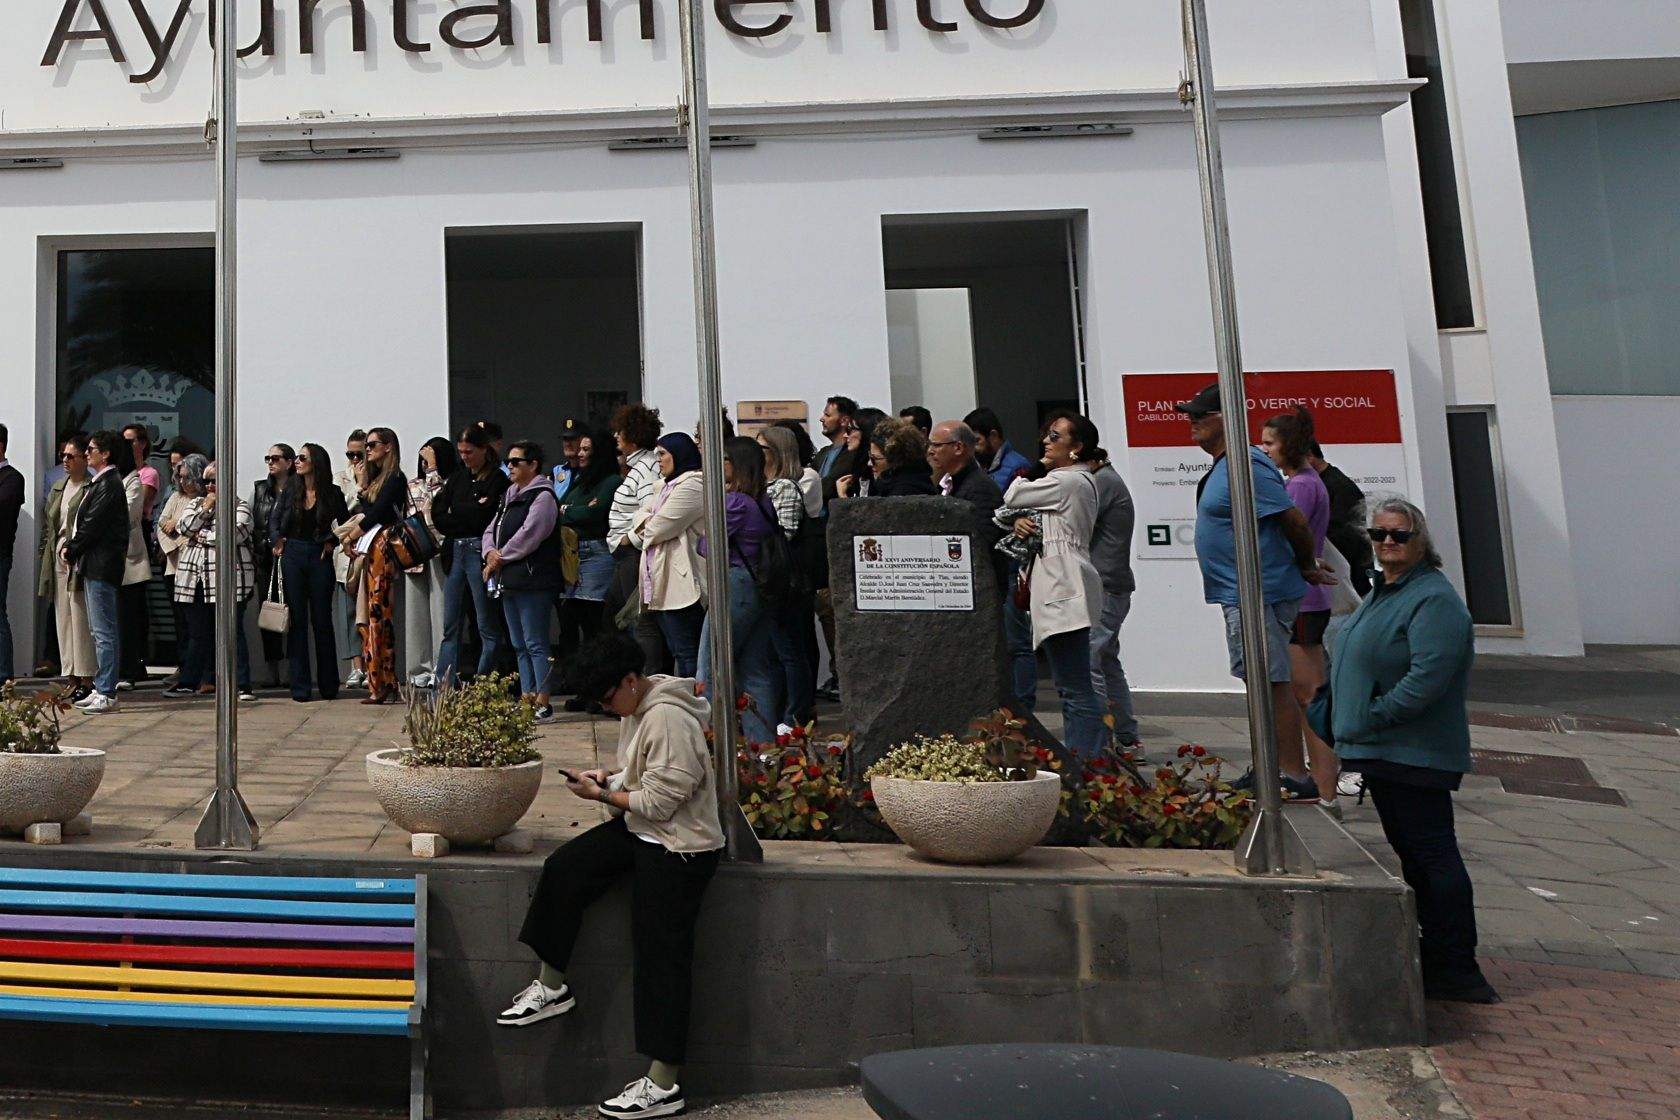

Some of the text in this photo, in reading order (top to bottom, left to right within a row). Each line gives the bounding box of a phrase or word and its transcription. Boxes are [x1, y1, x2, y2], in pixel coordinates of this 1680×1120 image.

[1138, 400, 1174, 411] PLAN
[1310, 398, 1320, 408] Y
[1324, 396, 1376, 408] SOCIAL
[1138, 413, 1176, 421] CABILDO
